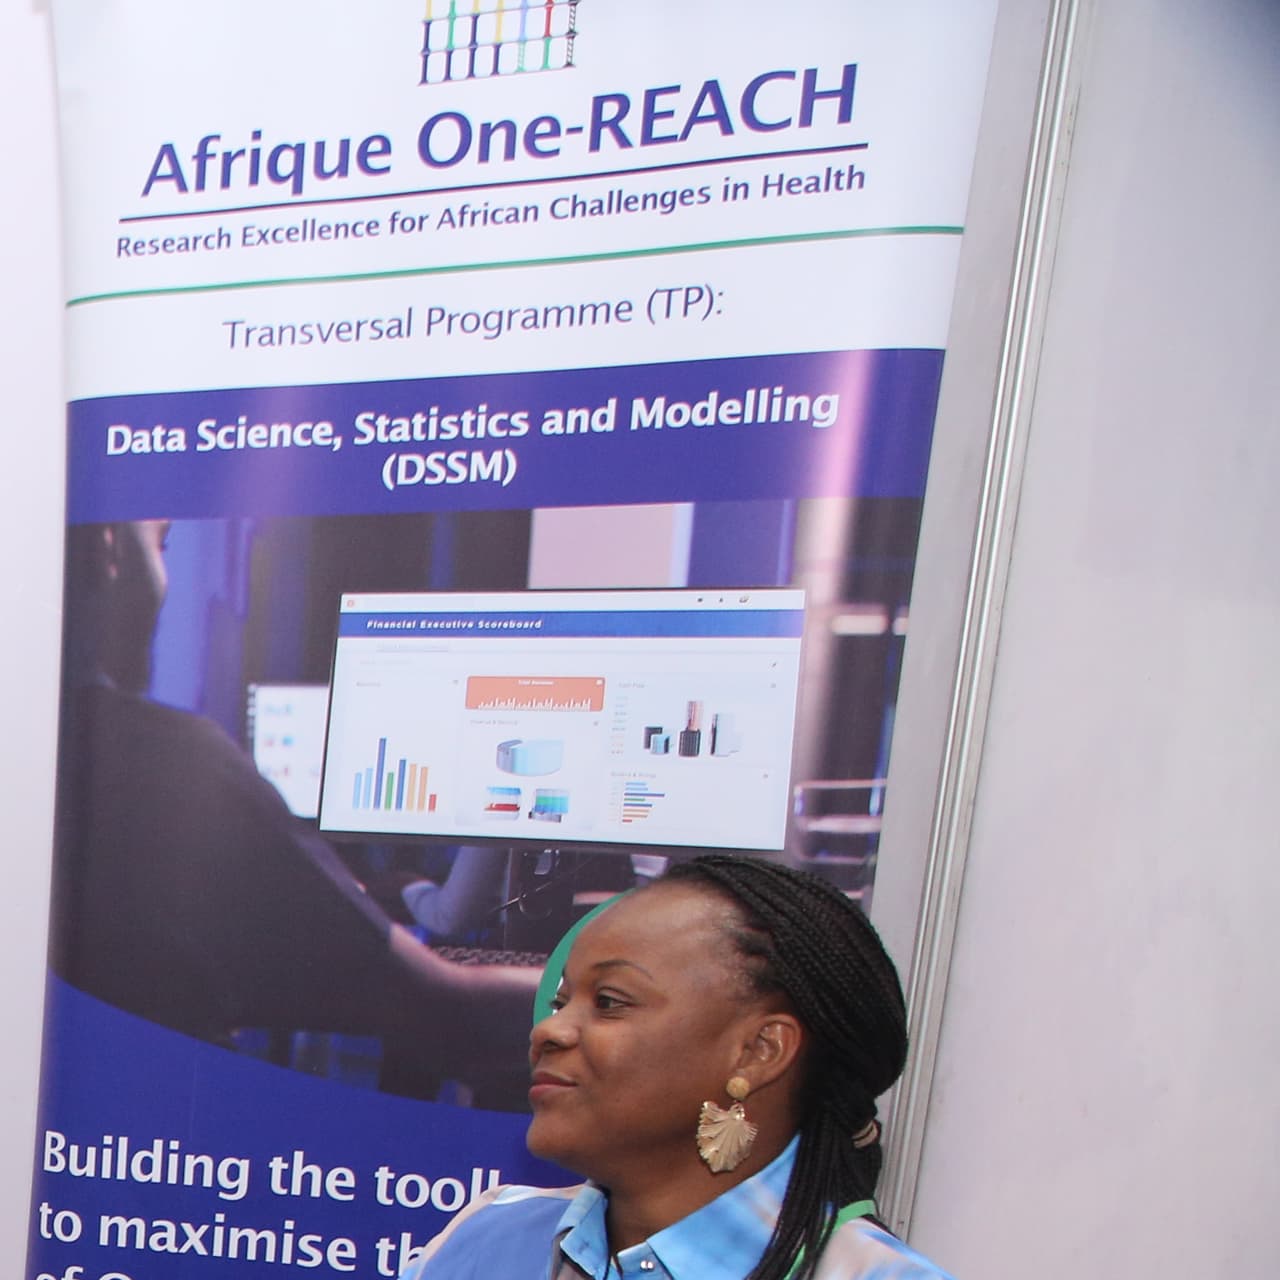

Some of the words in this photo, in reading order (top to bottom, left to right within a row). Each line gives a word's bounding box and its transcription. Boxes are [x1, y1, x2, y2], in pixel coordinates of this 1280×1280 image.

[141, 132, 393, 198] Afrique
[416, 64, 858, 170] One-REACH
[116, 224, 233, 259] Research
[241, 214, 380, 249] Excellence
[389, 208, 429, 238] for
[437, 199, 539, 231] African
[549, 180, 710, 225] Challenges
[721, 174, 749, 203] in
[762, 163, 866, 198] Health
[223, 310, 414, 351] Transversal
[425, 297, 633, 347] Programme
[646, 284, 725, 327] (TP):
[106, 422, 187, 458] Data
[196, 417, 343, 455] Science,
[354, 406, 530, 445] Statistics
[541, 402, 617, 437] and
[629, 385, 841, 434] Modelling
[381, 450, 517, 490] (DSSM)
[366, 619, 417, 630] Financial
[420, 619, 473, 630] Executive
[478, 618, 543, 630] Scoreboard
[43, 1129, 250, 1201] Building
[269, 1150, 357, 1201] the
[39, 1202, 82, 1243] to
[98, 1213, 357, 1273] maximise
[376, 1232, 428, 1277] th
